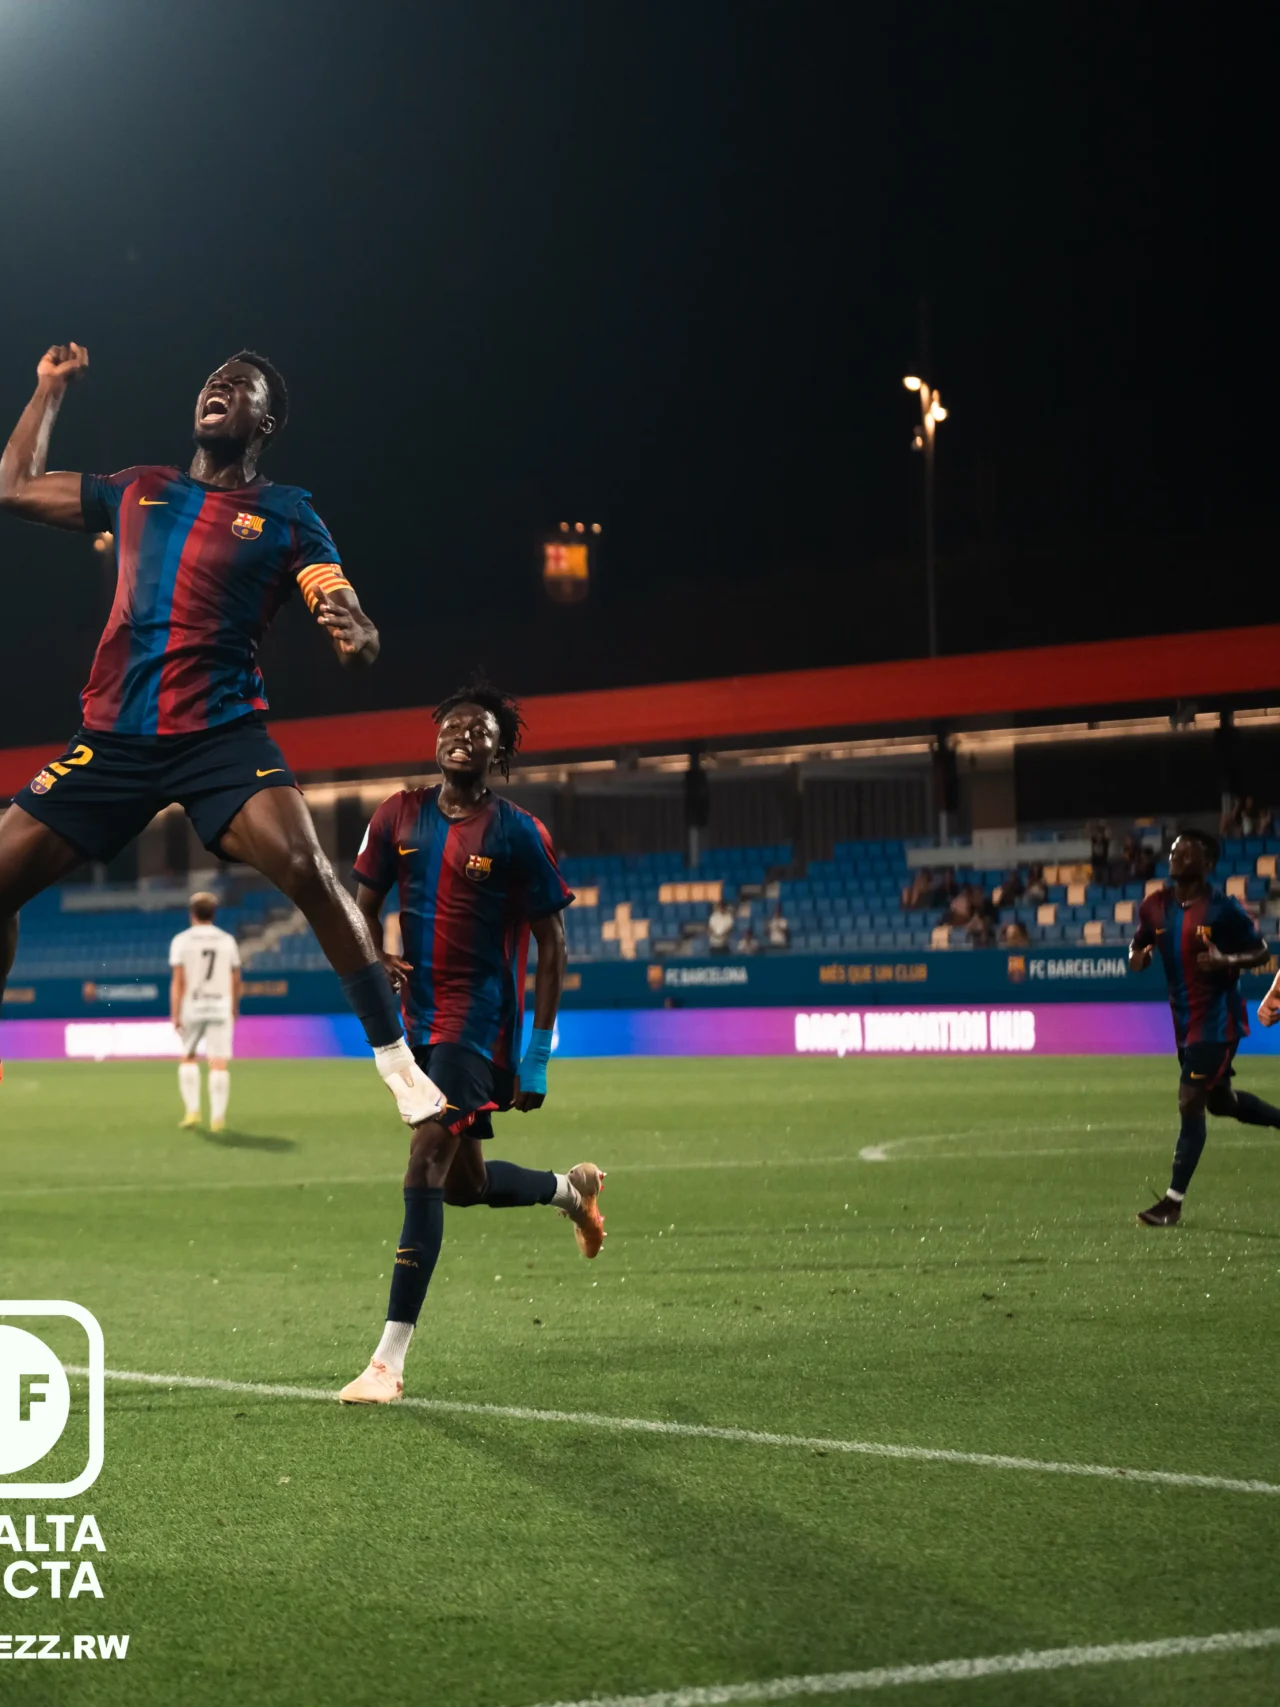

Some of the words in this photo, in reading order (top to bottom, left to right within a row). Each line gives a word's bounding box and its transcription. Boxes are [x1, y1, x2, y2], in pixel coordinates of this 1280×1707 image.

[201, 948, 216, 981] 7
[1029, 959, 1046, 980] FC
[1047, 957, 1127, 980] BARCELONA
